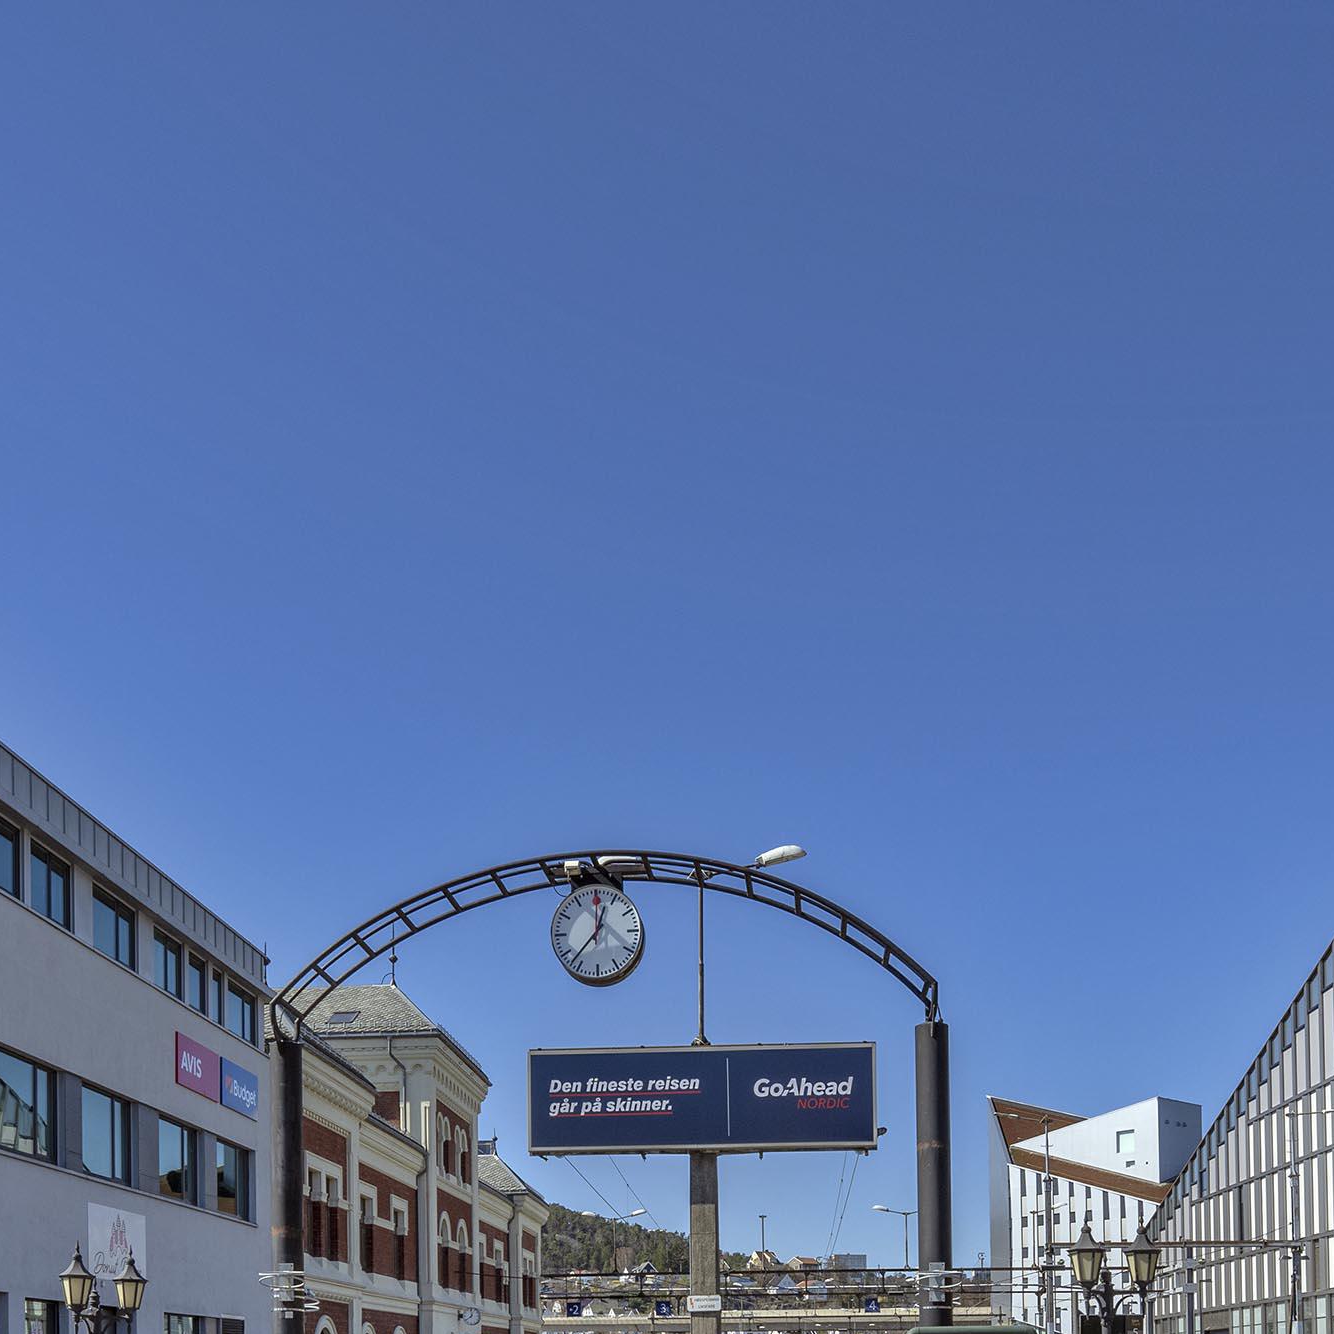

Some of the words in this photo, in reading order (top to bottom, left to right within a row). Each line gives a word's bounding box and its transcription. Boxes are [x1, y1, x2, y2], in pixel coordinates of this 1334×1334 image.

[180, 1050, 202, 1079] AVIS
[233, 1079, 257, 1108] Budget
[549, 1079, 582, 1094] Den
[586, 1077, 643, 1093] fineste
[647, 1076, 700, 1091] reisen
[753, 1076, 854, 1098] GoAhead
[549, 1098, 578, 1117] går
[580, 1097, 603, 1116] på
[605, 1096, 673, 1113] skinner.
[797, 1098, 850, 1110] NORDIC
[573, 1306, 579, 1315] 2
[660, 1303, 667, 1314] 3
[869, 1300, 877, 1310] 4
